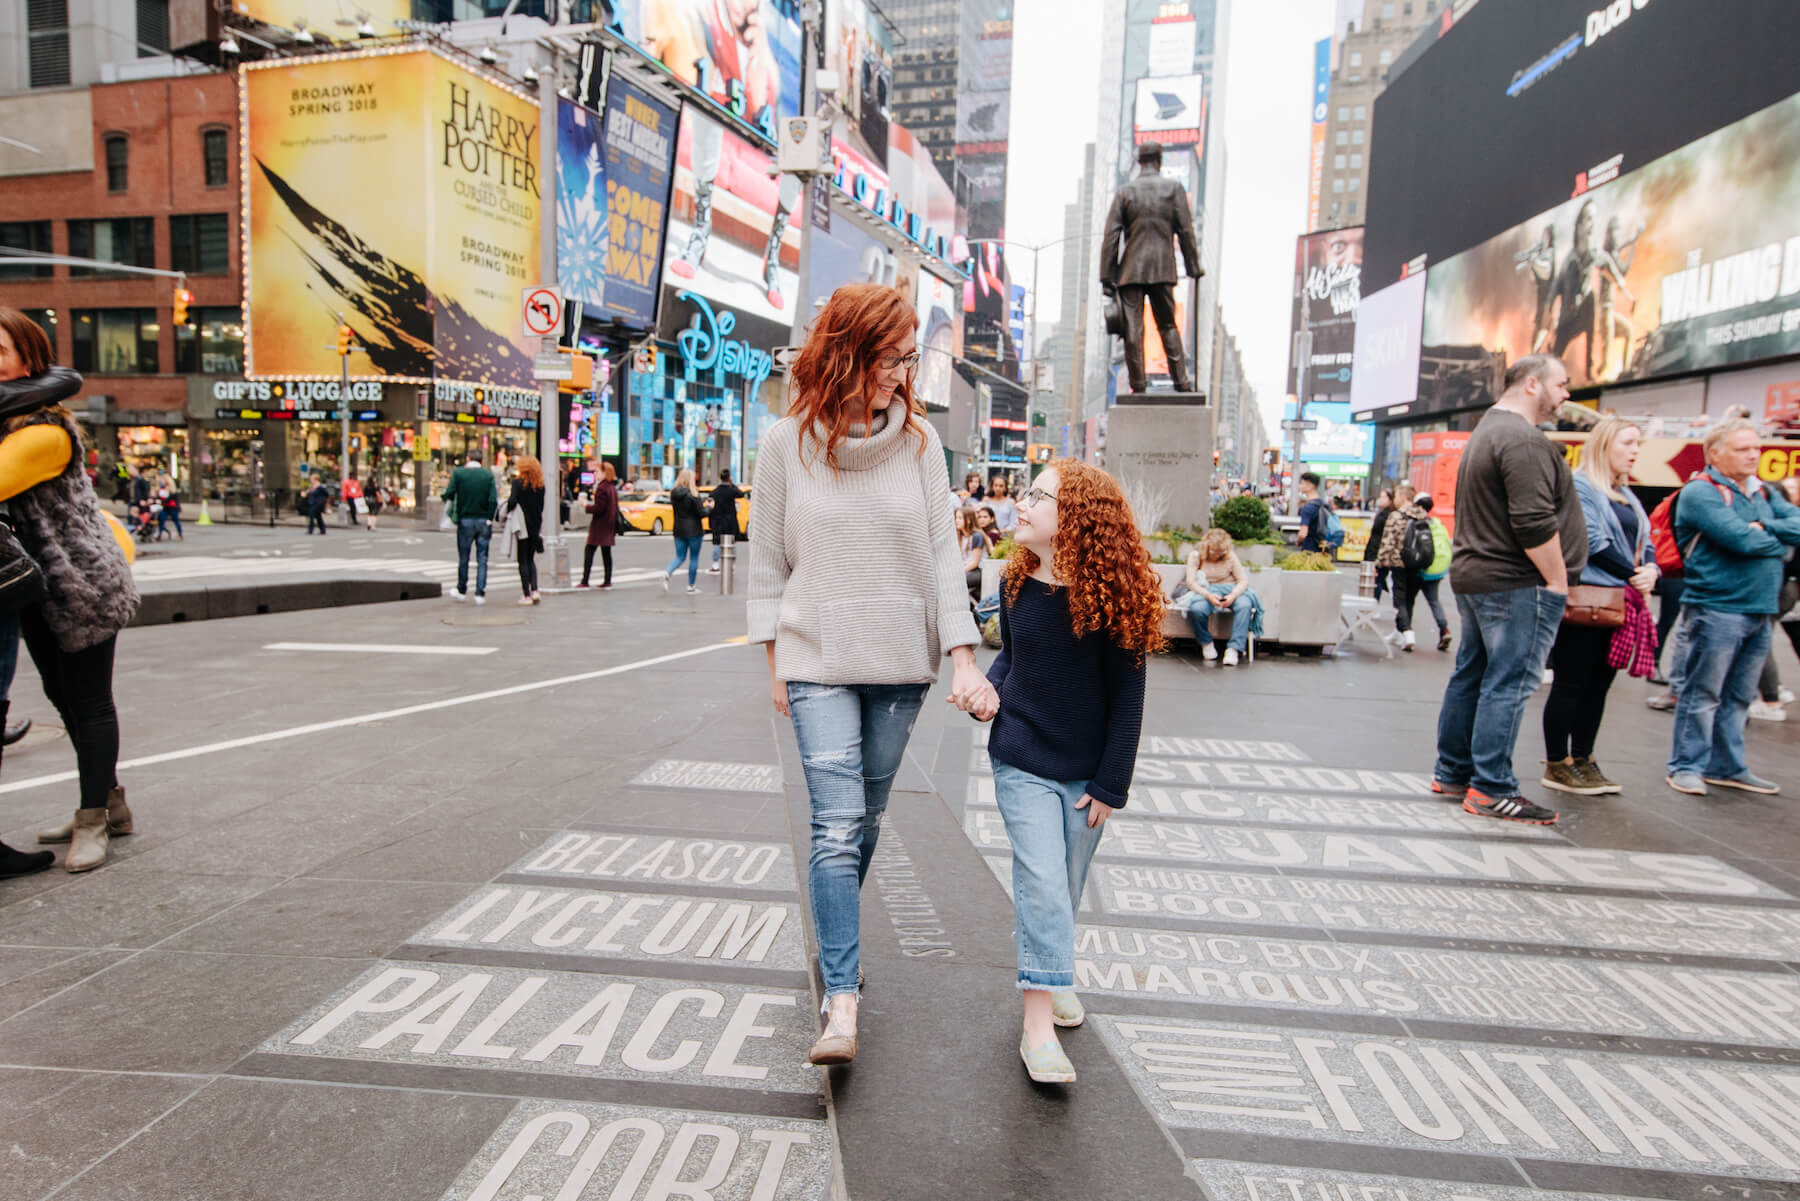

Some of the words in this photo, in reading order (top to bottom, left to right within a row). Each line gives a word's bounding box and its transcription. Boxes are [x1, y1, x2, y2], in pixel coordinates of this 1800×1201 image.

[289, 101, 342, 117] SPRING
[348, 98, 377, 112] 2018
[291, 82, 375, 101] BROADWAY
[449, 80, 537, 161] HARRY
[1134, 128, 1199, 146] TOSHIBA
[442, 120, 542, 200] POTTER
[460, 251, 501, 273] SPRING
[461, 235, 524, 265] BROADWAY
[1661, 242, 1781, 326] WALKING
[213, 382, 271, 400] GIFTS
[435, 382, 475, 403] GIFTS
[483, 387, 540, 413] LUGGAGE
[642, 771, 774, 791] SONDHEIM
[659, 760, 772, 777] STEPHEN
[525, 832, 781, 885] BELASCO
[1218, 830, 1759, 894] JAMES
[431, 889, 789, 963] LYCEUM
[1110, 868, 1278, 897] SHUBERT
[1290, 879, 1526, 914] BROADHURST
[1528, 894, 1800, 934] MAJESTI
[1114, 890, 1367, 928] BOOTH
[1074, 928, 1248, 965] MUSIC
[1255, 940, 1384, 975] BOX
[1394, 950, 1600, 993] RICHARD
[1073, 959, 1420, 1013] MARQUIS
[1419, 991, 1650, 1031] RODGERS
[289, 967, 797, 1080] PALACE
[470, 1111, 812, 1201] CORT
